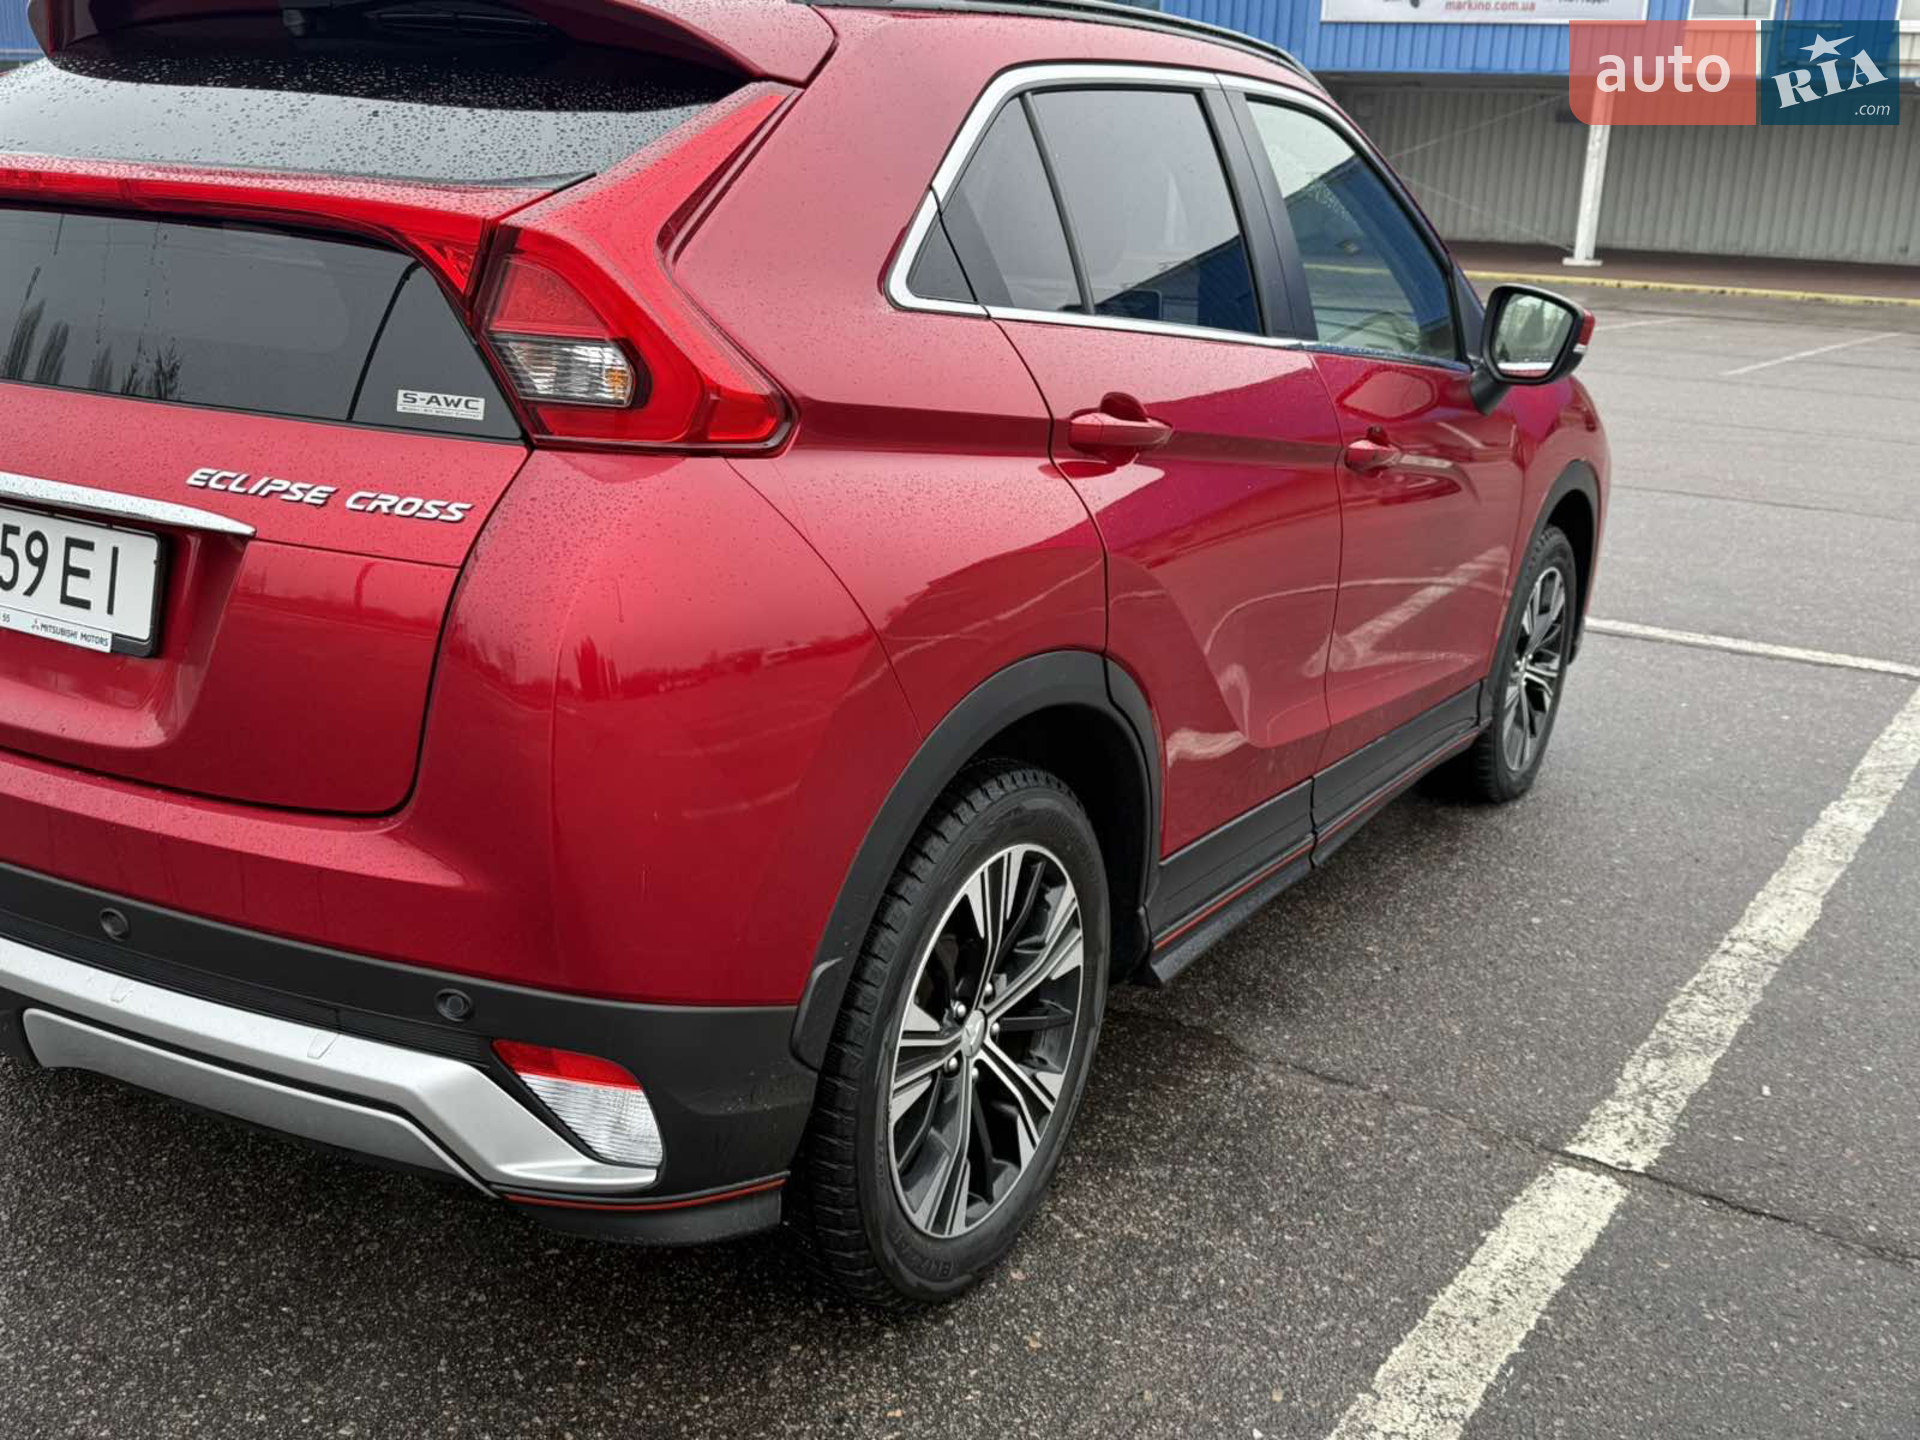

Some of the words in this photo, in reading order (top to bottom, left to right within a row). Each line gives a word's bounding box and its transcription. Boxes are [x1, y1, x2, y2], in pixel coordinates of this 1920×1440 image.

[402, 392, 480, 410] S-AWC
[186, 468, 336, 505] ECLIPSE
[345, 491, 473, 522] CROSS
[0, 523, 49, 597] 59
[60, 536, 119, 615] EI
[40, 623, 78, 639] MITSUBISHI
[80, 632, 109, 646] MOTORS
